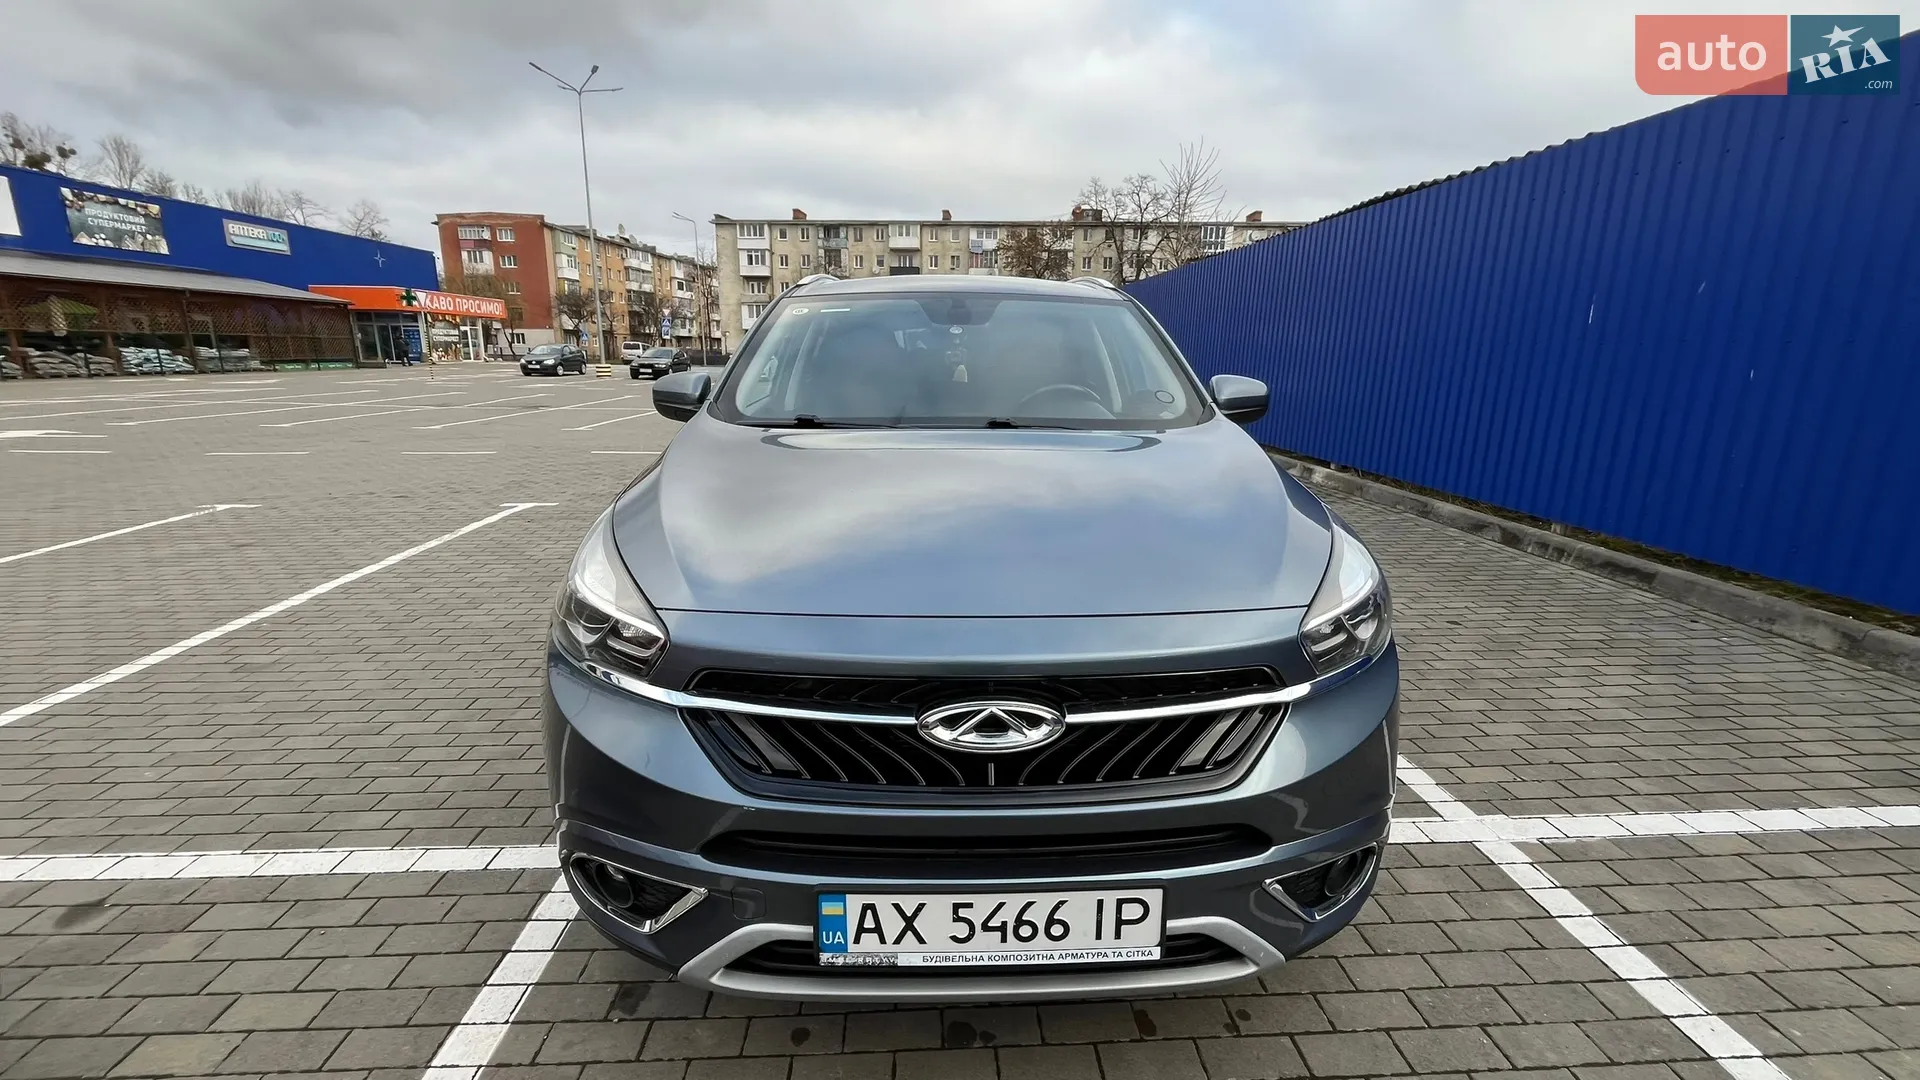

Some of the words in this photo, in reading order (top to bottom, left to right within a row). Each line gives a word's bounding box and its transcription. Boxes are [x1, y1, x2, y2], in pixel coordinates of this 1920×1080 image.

[85, 208, 146, 225] ПРОДУКТОВИЙ
[88, 217, 148, 233] СУПЕРМАРКЕТ
[228, 224, 267, 239] АПТЕКА
[455, 298, 503, 315] ПРОСИМО!
[852, 902, 928, 945] AX
[948, 899, 1071, 944] 5466
[822, 931, 844, 945] UA
[922, 955, 985, 963] БУДІВЕЛЬНА
[987, 953, 1055, 962] КОМПОЗИТНА
[1057, 951, 1107, 960] АРМАТУРА
[1110, 950, 1124, 958] ТА
[1126, 948, 1154, 958] СІТКА
